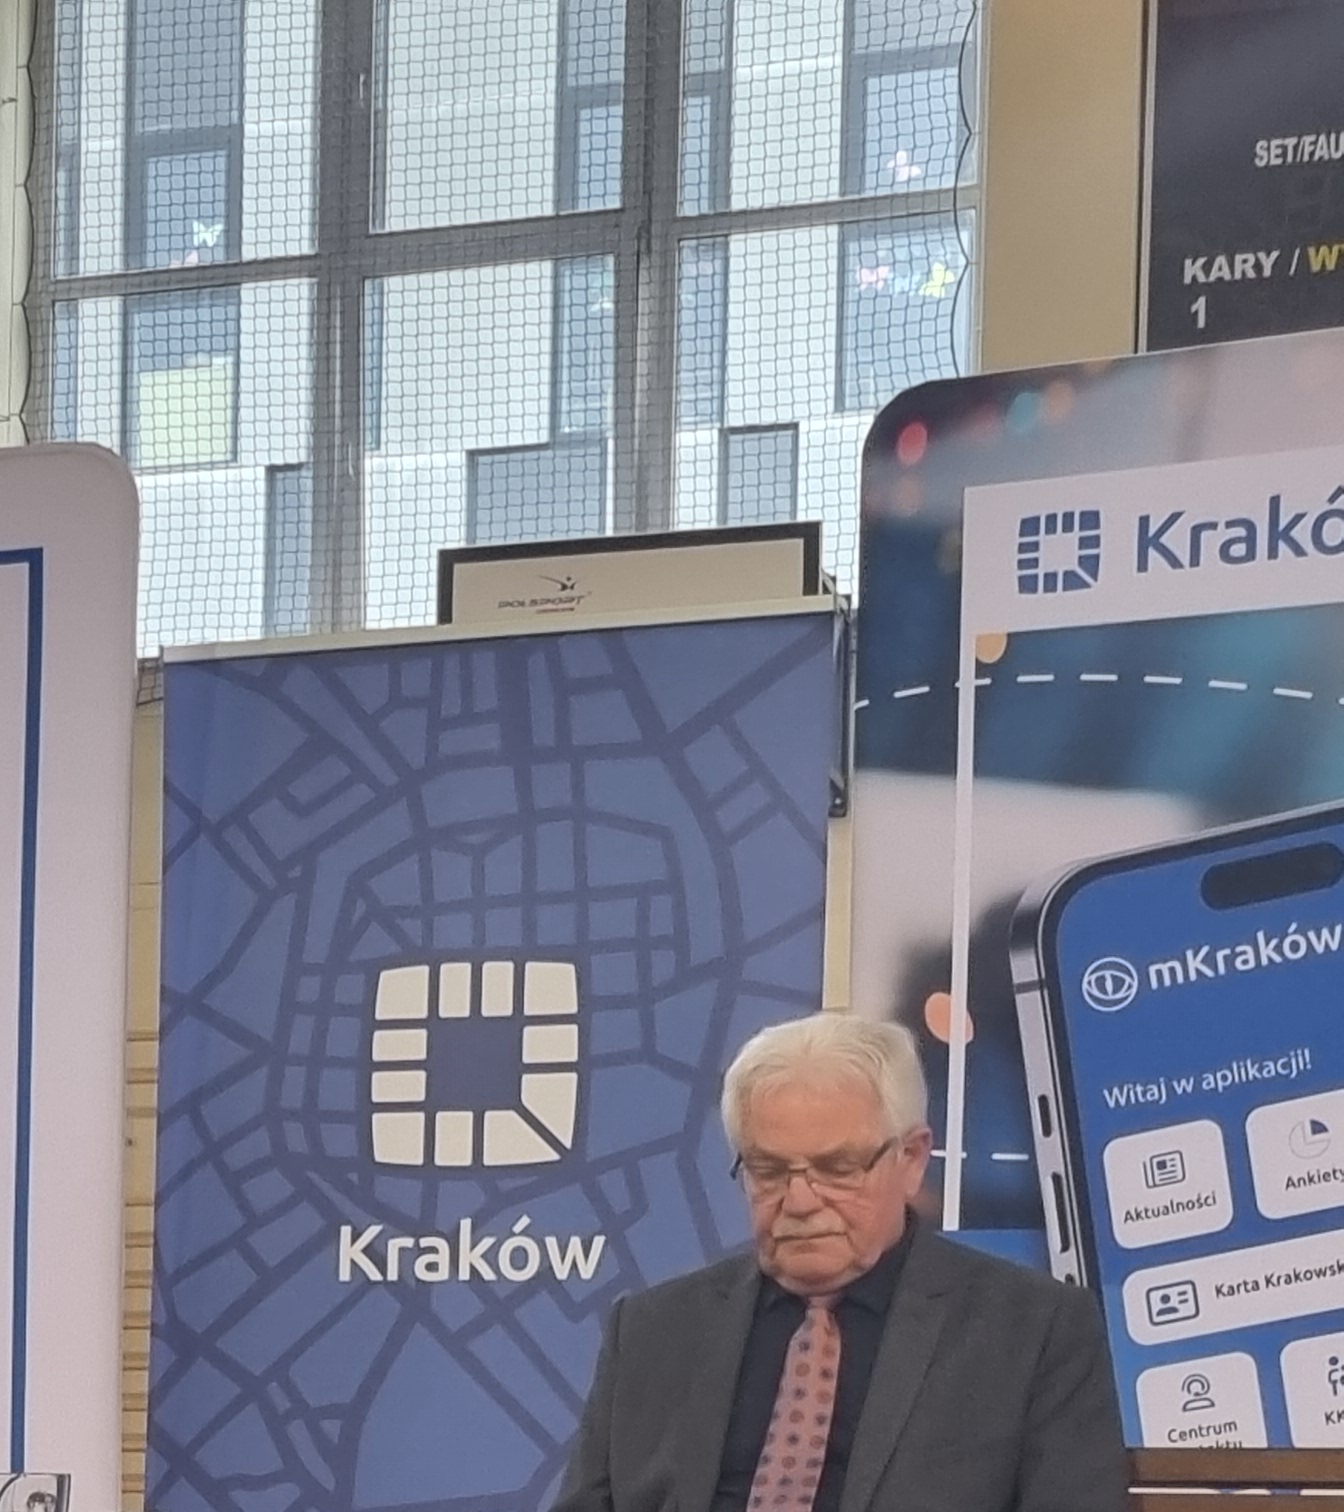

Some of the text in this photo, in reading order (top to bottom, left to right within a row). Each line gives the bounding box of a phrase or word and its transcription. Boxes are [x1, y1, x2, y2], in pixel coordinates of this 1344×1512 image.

[1183, 249, 1281, 285] KARY
[1307, 243, 1344, 273] W
[1190, 295, 1207, 329] 1
[1148, 922, 1344, 990] mKraków
[1103, 1047, 1313, 1109] Witaj w aplikacji!
[1122, 1190, 1217, 1224] Aktualności
[338, 1213, 607, 1283] Kraków
[1215, 1279, 1261, 1299] Karta
[1167, 1420, 1238, 1443] Centrum
